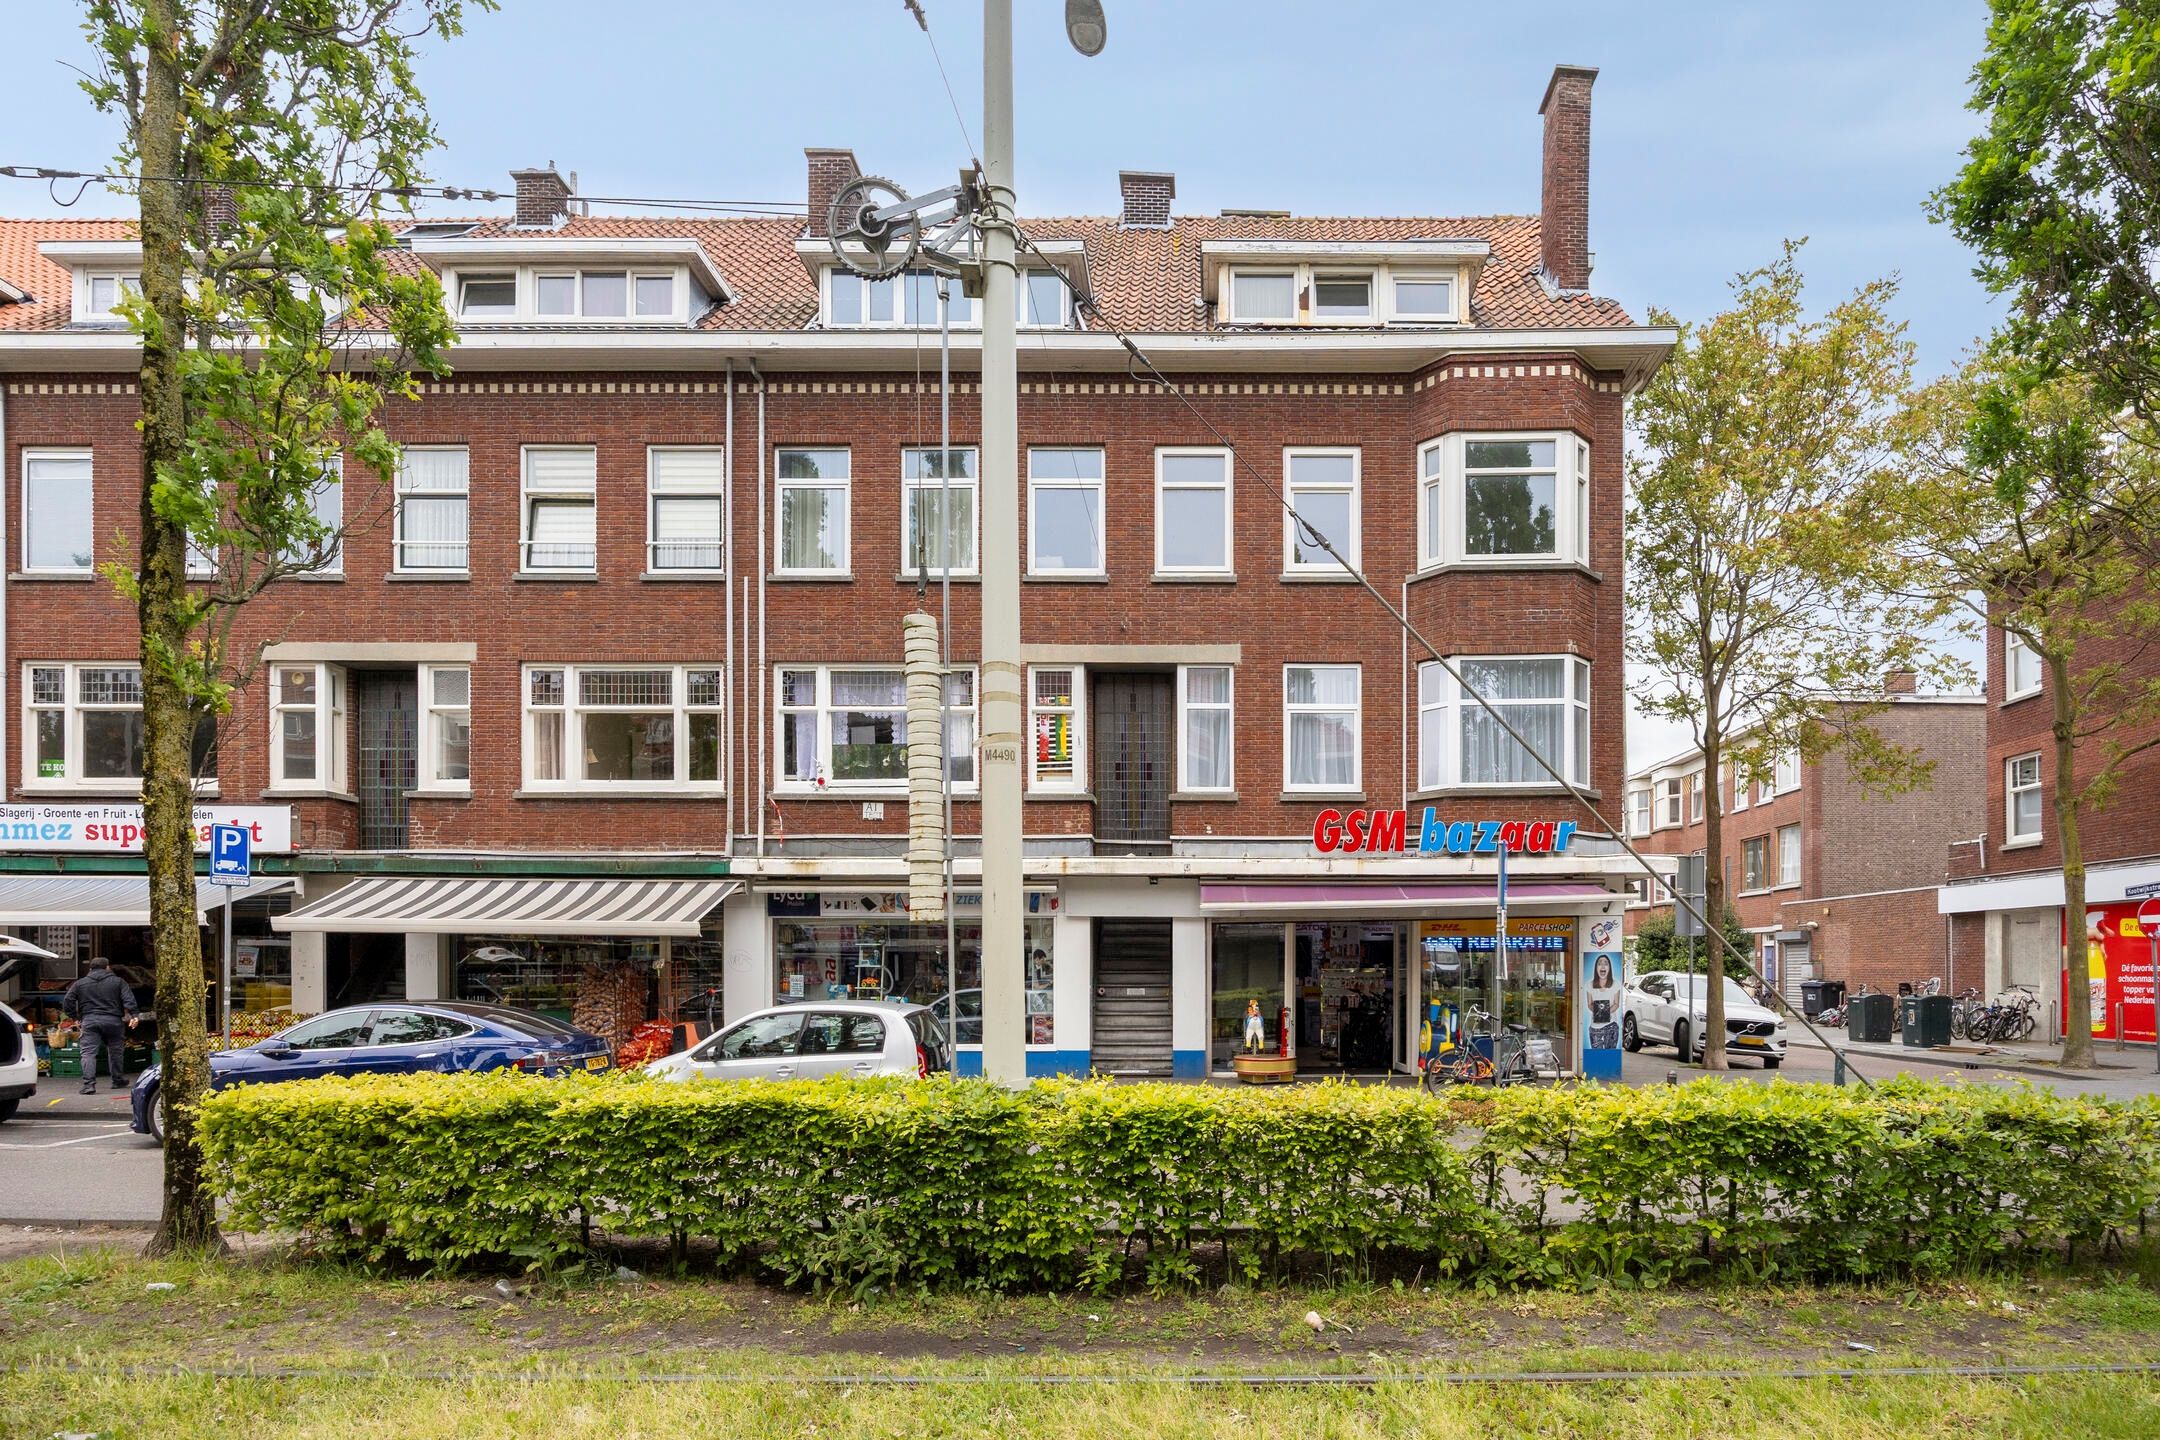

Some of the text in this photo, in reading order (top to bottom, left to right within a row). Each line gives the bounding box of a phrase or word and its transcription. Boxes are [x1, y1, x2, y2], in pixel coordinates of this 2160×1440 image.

[985, 749, 1016, 761] M4490
[40, 763, 51, 771] TE
[0, 808, 35, 820] Slagerij
[43, 808, 82, 819] Groente
[104, 809, 127, 819] Fruit
[1313, 806, 1577, 854] GSM bazaar
[221, 829, 242, 855] P
[1430, 923, 1462, 931] DHL
[1519, 923, 1571, 932] PARCELSHOP
[2123, 986, 2145, 995] topper
